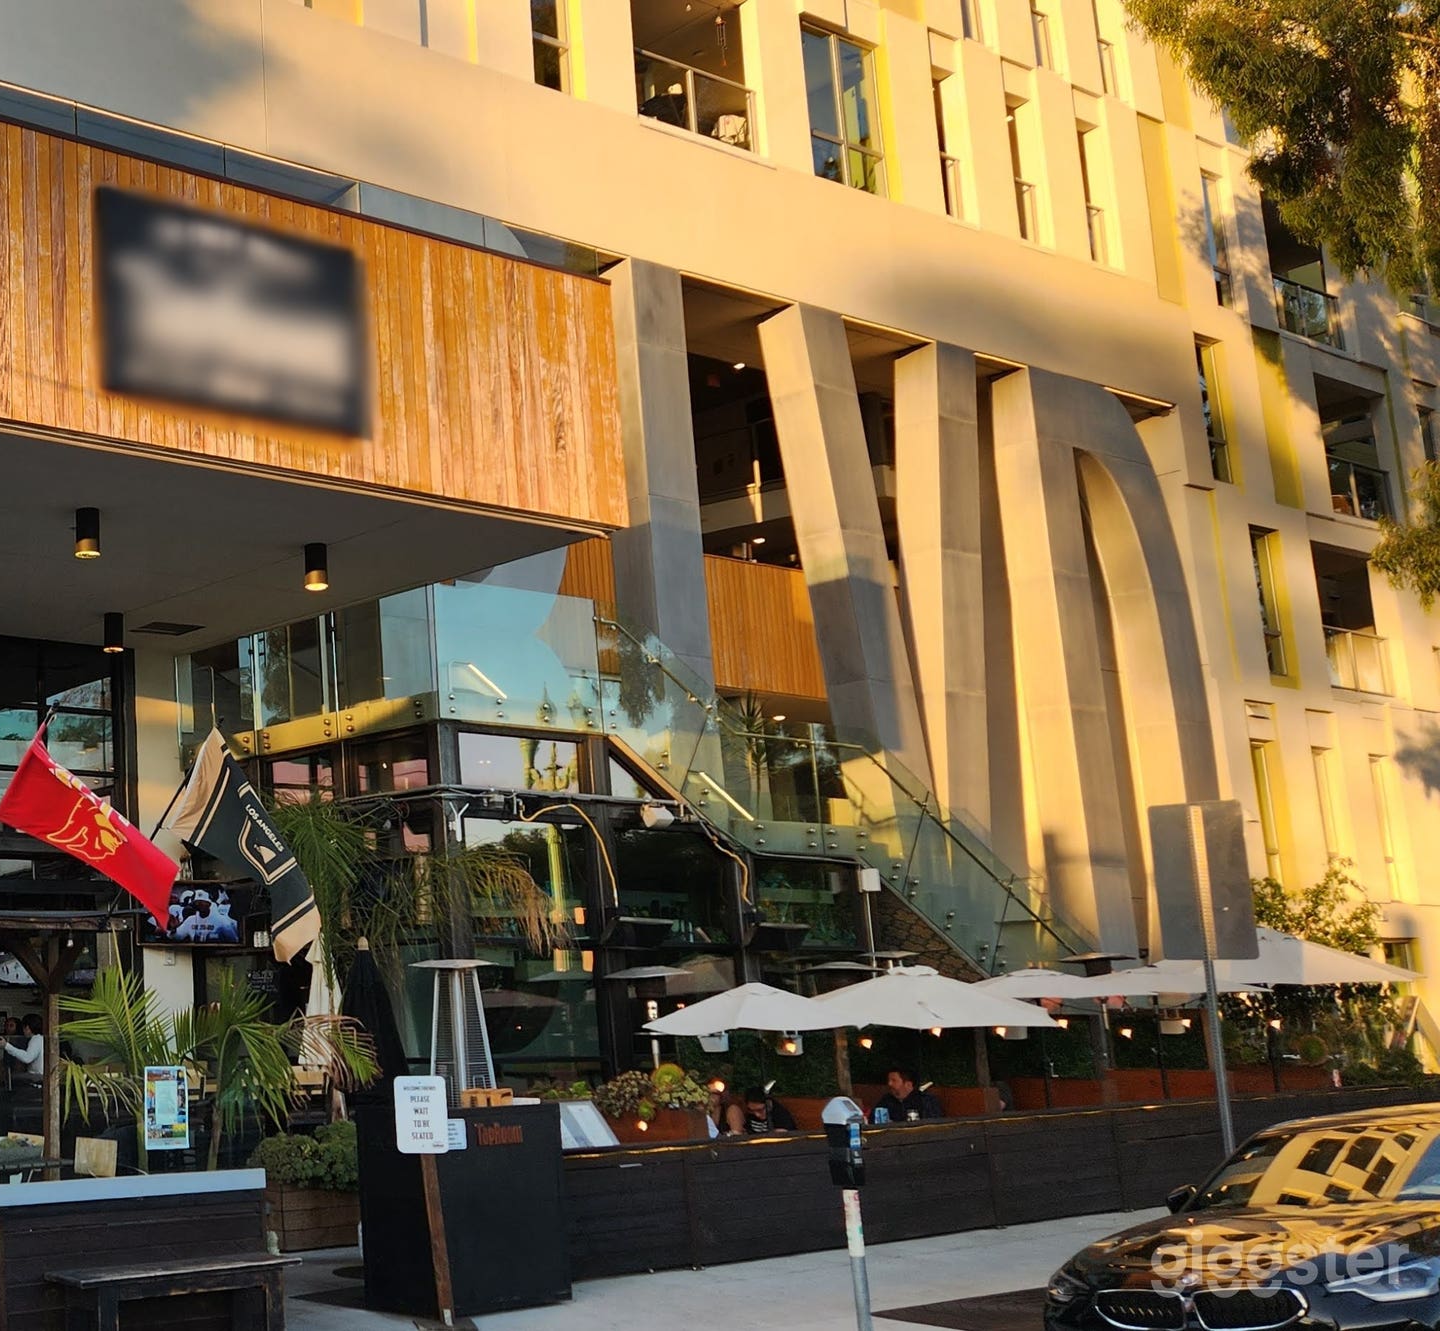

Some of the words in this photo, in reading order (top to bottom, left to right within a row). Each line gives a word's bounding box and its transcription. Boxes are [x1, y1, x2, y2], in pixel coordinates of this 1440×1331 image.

[245, 803, 260, 820] LOS
[256, 819, 285, 852] ANGELES
[410, 1095, 430, 1103] PLEASE
[413, 1107, 428, 1115] WAIT
[413, 1119, 421, 1128] TO
[422, 1119, 430, 1128] BE
[412, 1131, 434, 1140] SEATED
